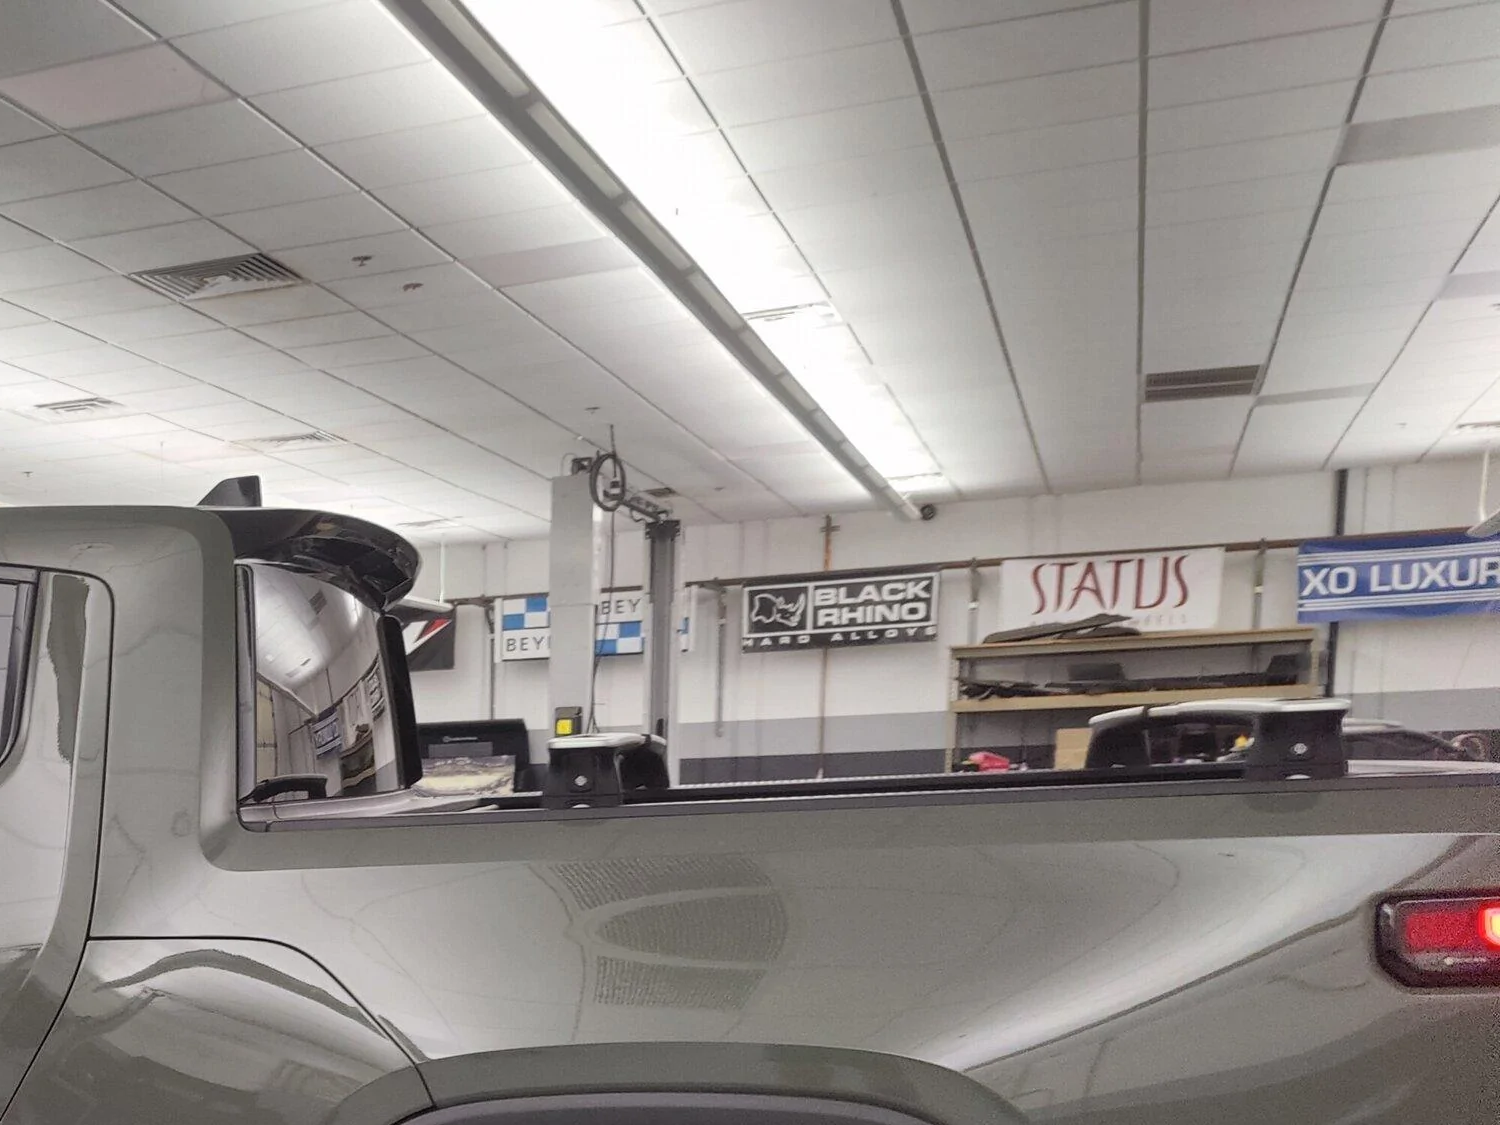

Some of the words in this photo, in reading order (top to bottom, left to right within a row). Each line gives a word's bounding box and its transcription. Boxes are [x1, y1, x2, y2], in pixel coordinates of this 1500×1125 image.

[814, 579, 931, 607] BLACK
[1031, 554, 1190, 615] STATUS
[1300, 565, 1358, 597] XO
[816, 602, 928, 627] RHINO
[506, 636, 551, 652] BEY
[742, 634, 812, 647] HARD
[830, 626, 938, 642] ALLOYS
